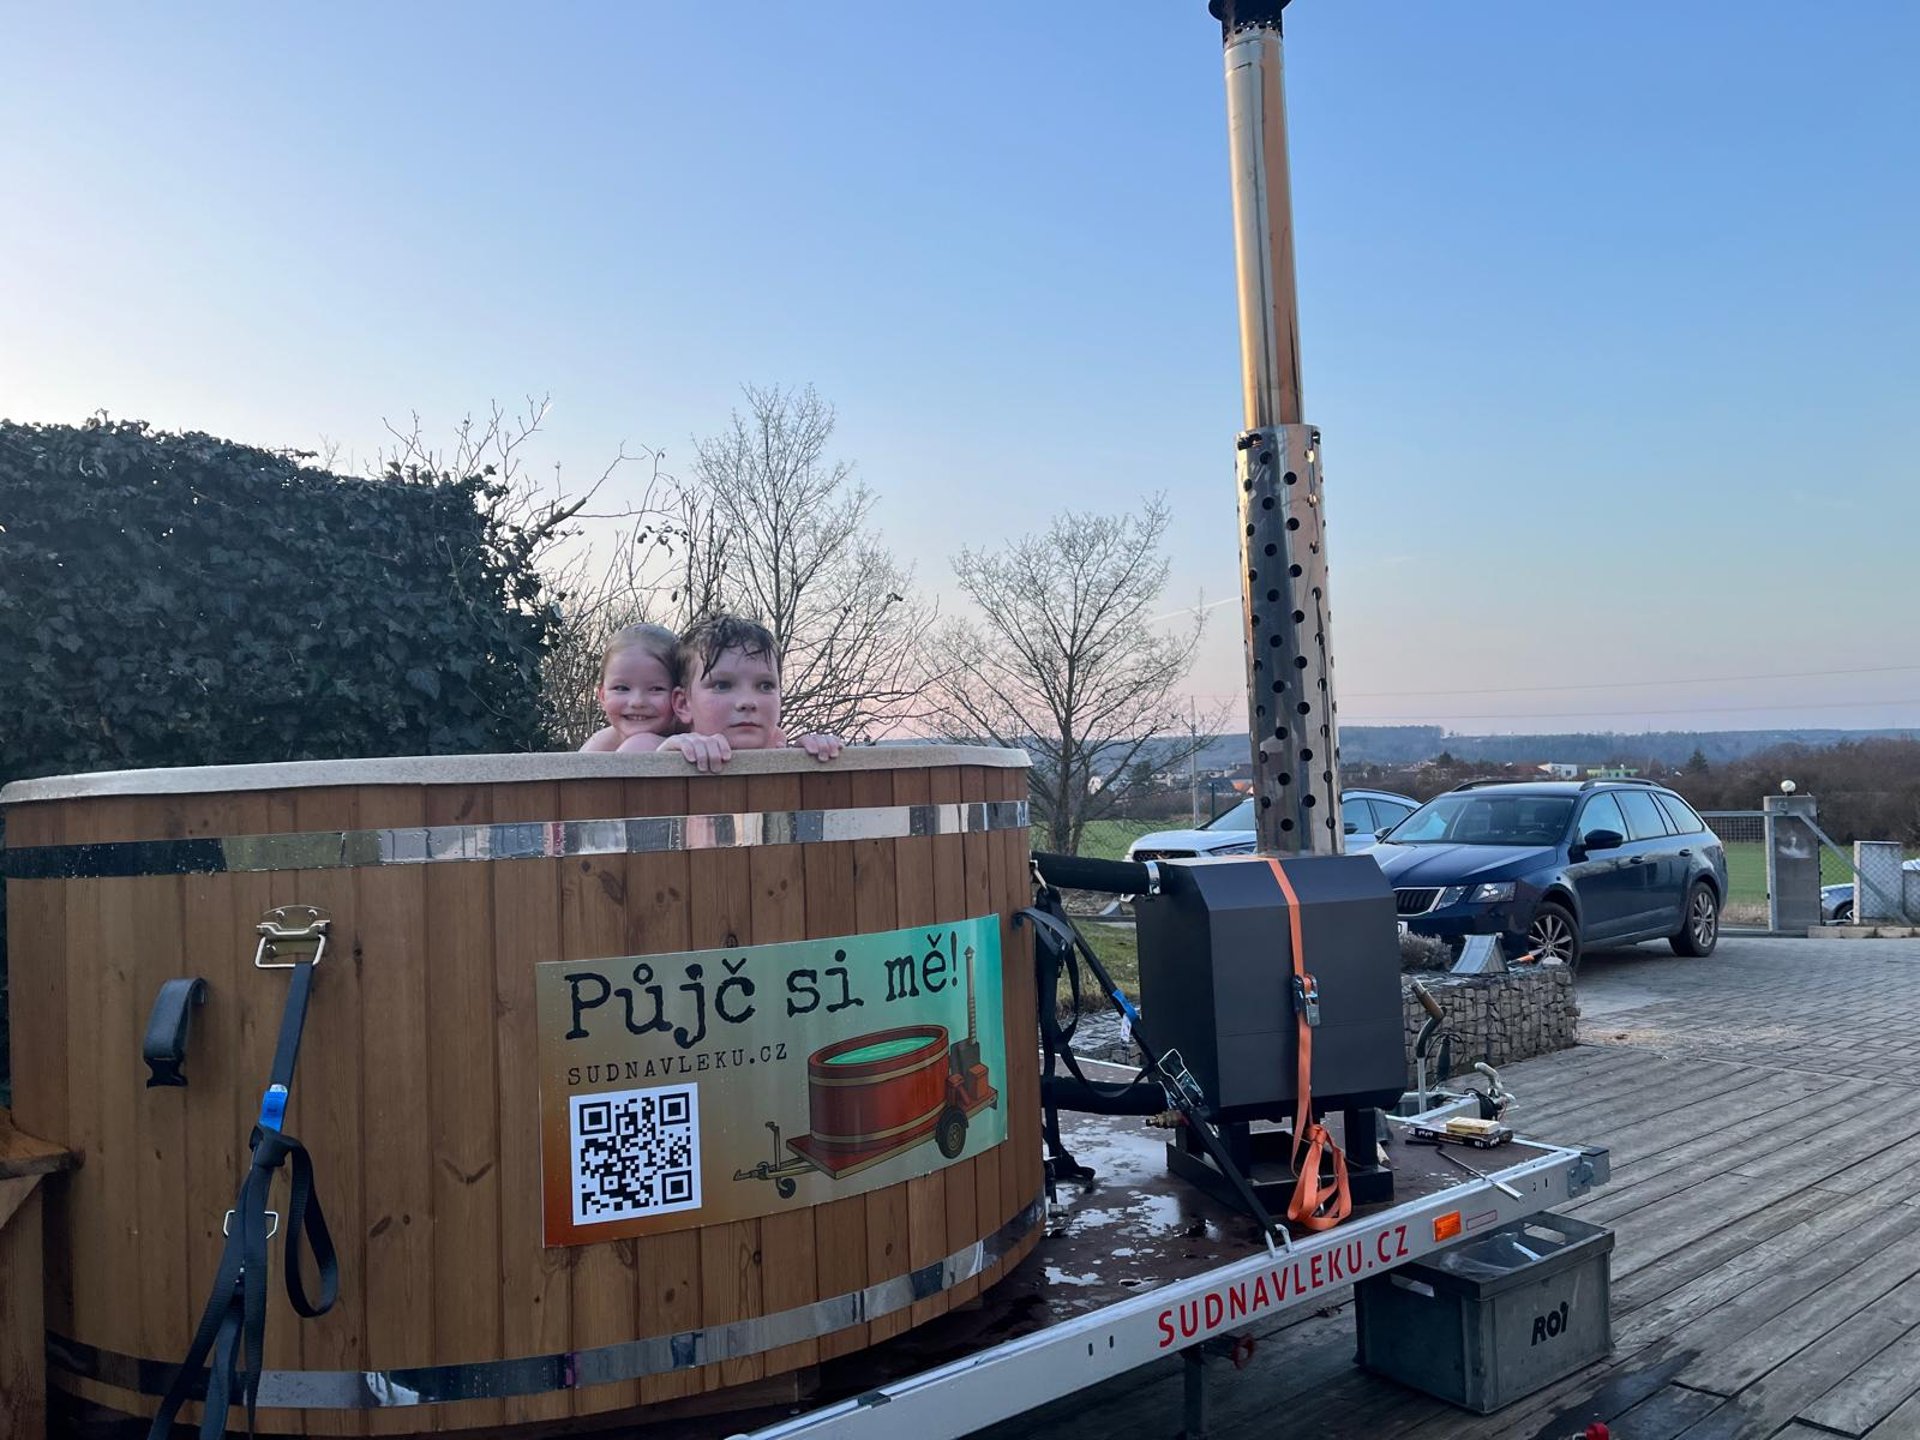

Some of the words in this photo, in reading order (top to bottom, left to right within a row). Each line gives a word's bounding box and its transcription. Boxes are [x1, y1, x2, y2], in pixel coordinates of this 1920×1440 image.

[564, 958, 756, 1049] Půjč
[786, 949, 864, 1018] si
[884, 931, 960, 1003] mě!
[568, 1043, 788, 1086] SUDNAVLEKU.CZ
[1158, 1225, 1408, 1348] SUDNAVLEKU.CZ
